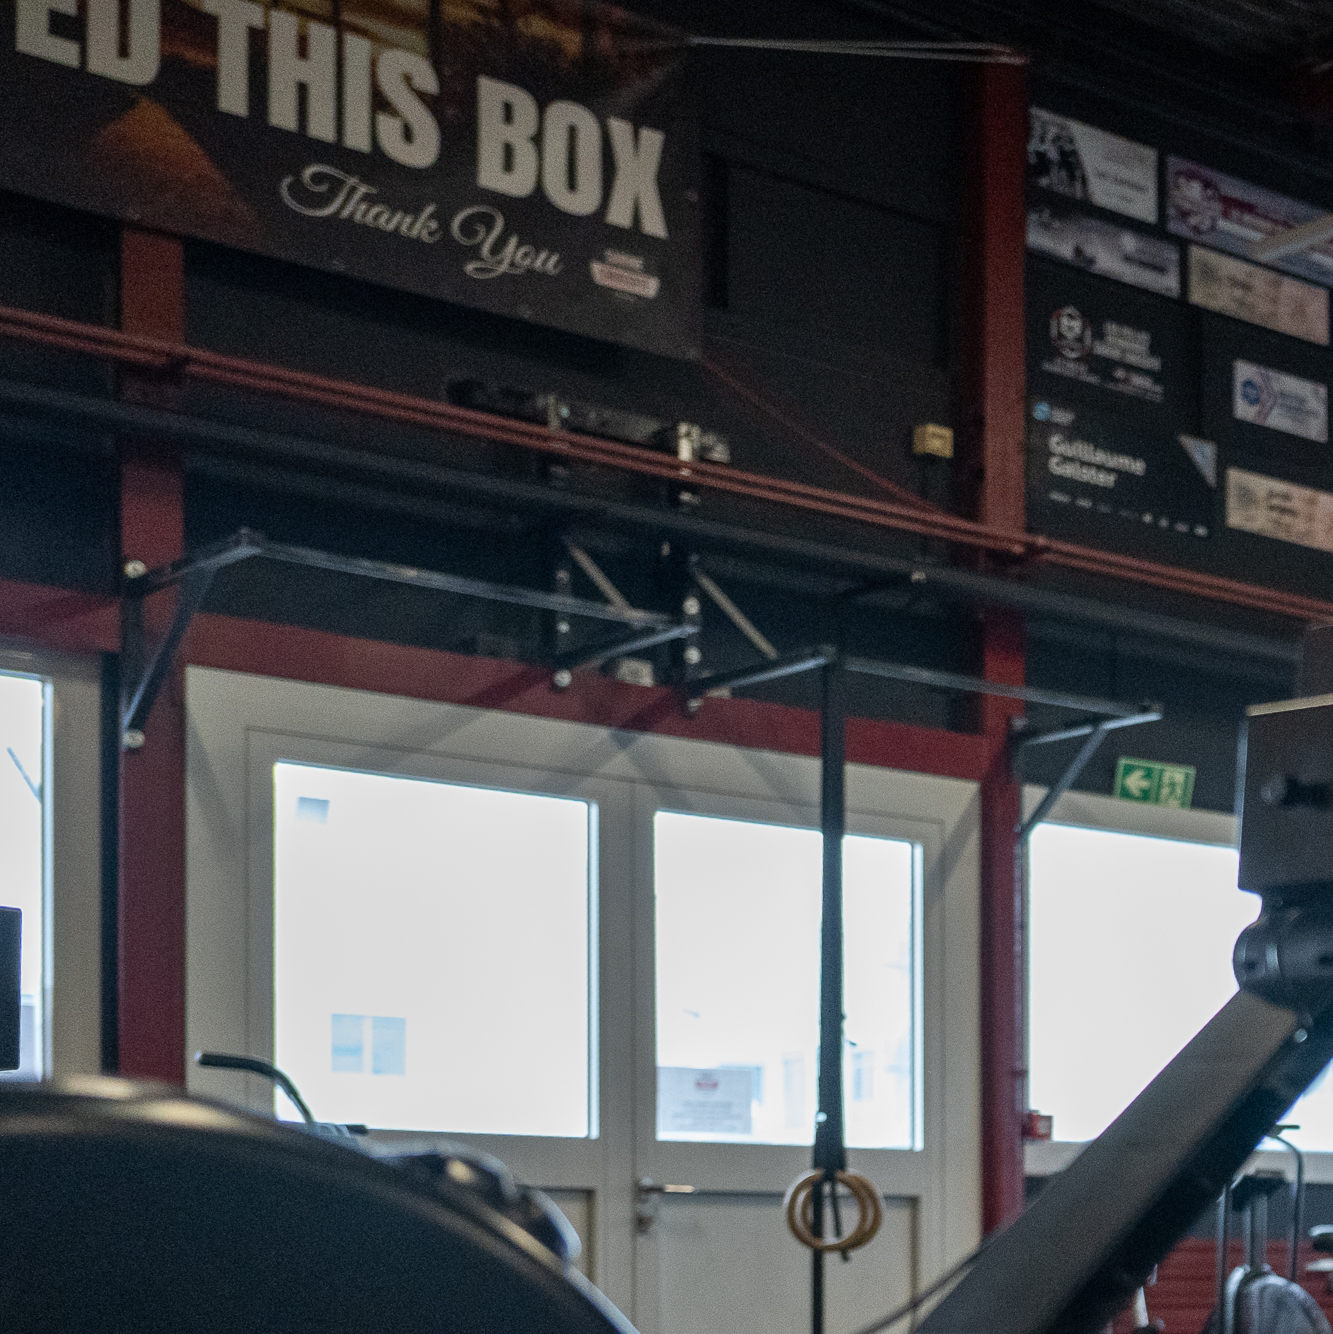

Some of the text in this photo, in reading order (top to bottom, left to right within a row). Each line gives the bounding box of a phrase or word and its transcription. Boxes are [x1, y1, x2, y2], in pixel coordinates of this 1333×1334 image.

[203, 0, 442, 169] THIS
[476, 75, 669, 240] BOX
[280, 163, 442, 245] Thank
[450, 205, 564, 280] You
